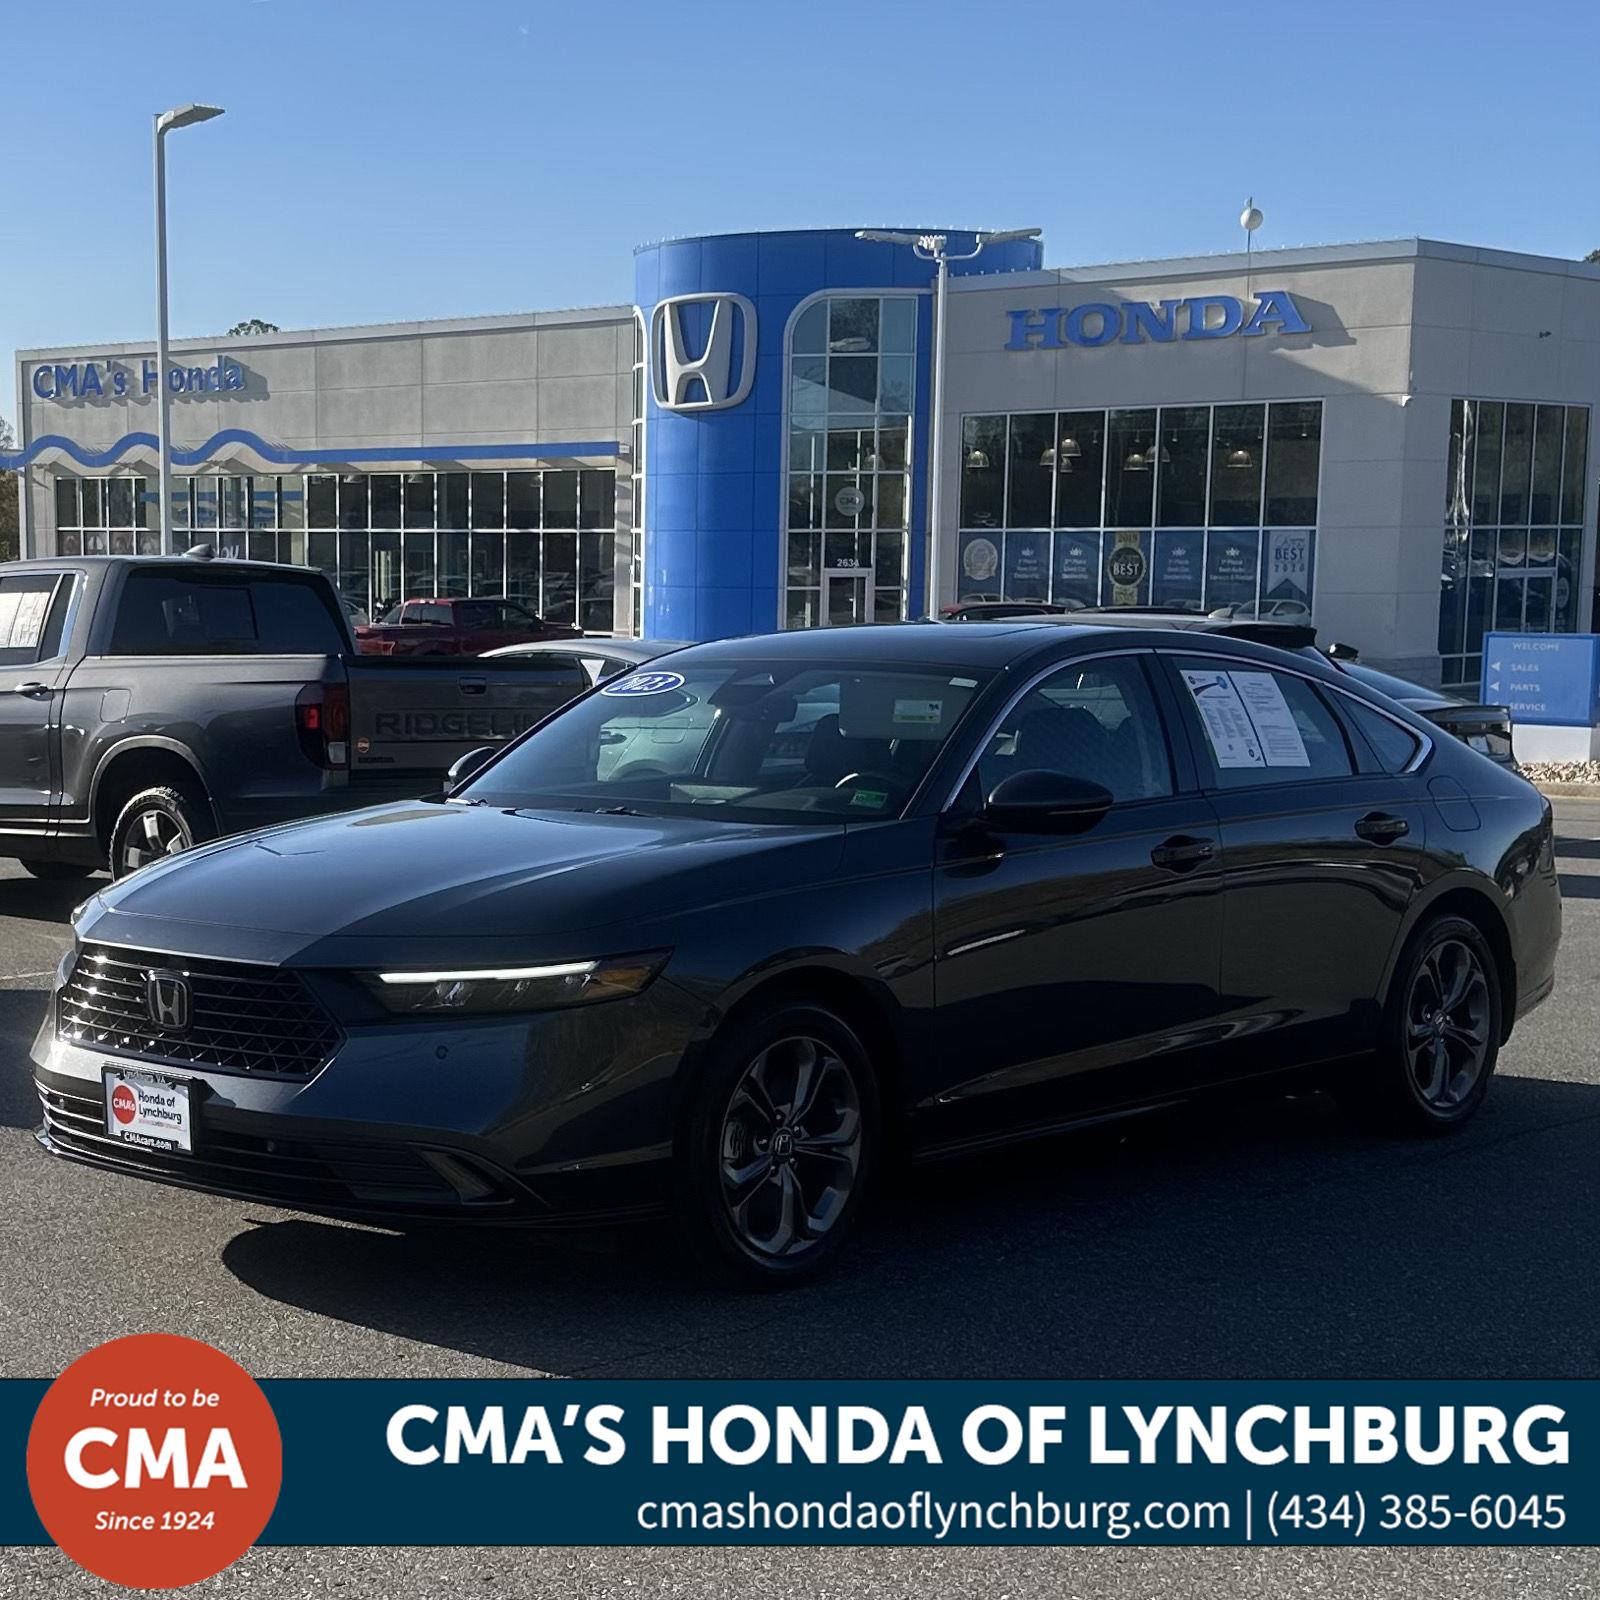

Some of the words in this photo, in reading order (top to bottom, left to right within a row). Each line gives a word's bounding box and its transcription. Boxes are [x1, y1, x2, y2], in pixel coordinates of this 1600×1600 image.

[1004, 290, 1313, 352] HONDA
[33, 360, 127, 399] CMA's
[142, 354, 246, 394] Honda
[1274, 547, 1304, 561] BEST
[837, 558, 860, 567] 2634
[1113, 562, 1140, 576] BEST
[1513, 642, 1560, 651] WELCOME
[1511, 663, 1539, 672] SALES
[607, 676, 675, 692] 2023
[1510, 683, 1541, 692] PARTS
[1509, 703, 1547, 712] SERVICE
[138, 1090, 166, 1106] Honda
[166, 1096, 176, 1108] of
[138, 1106, 182, 1125] Lynchburg
